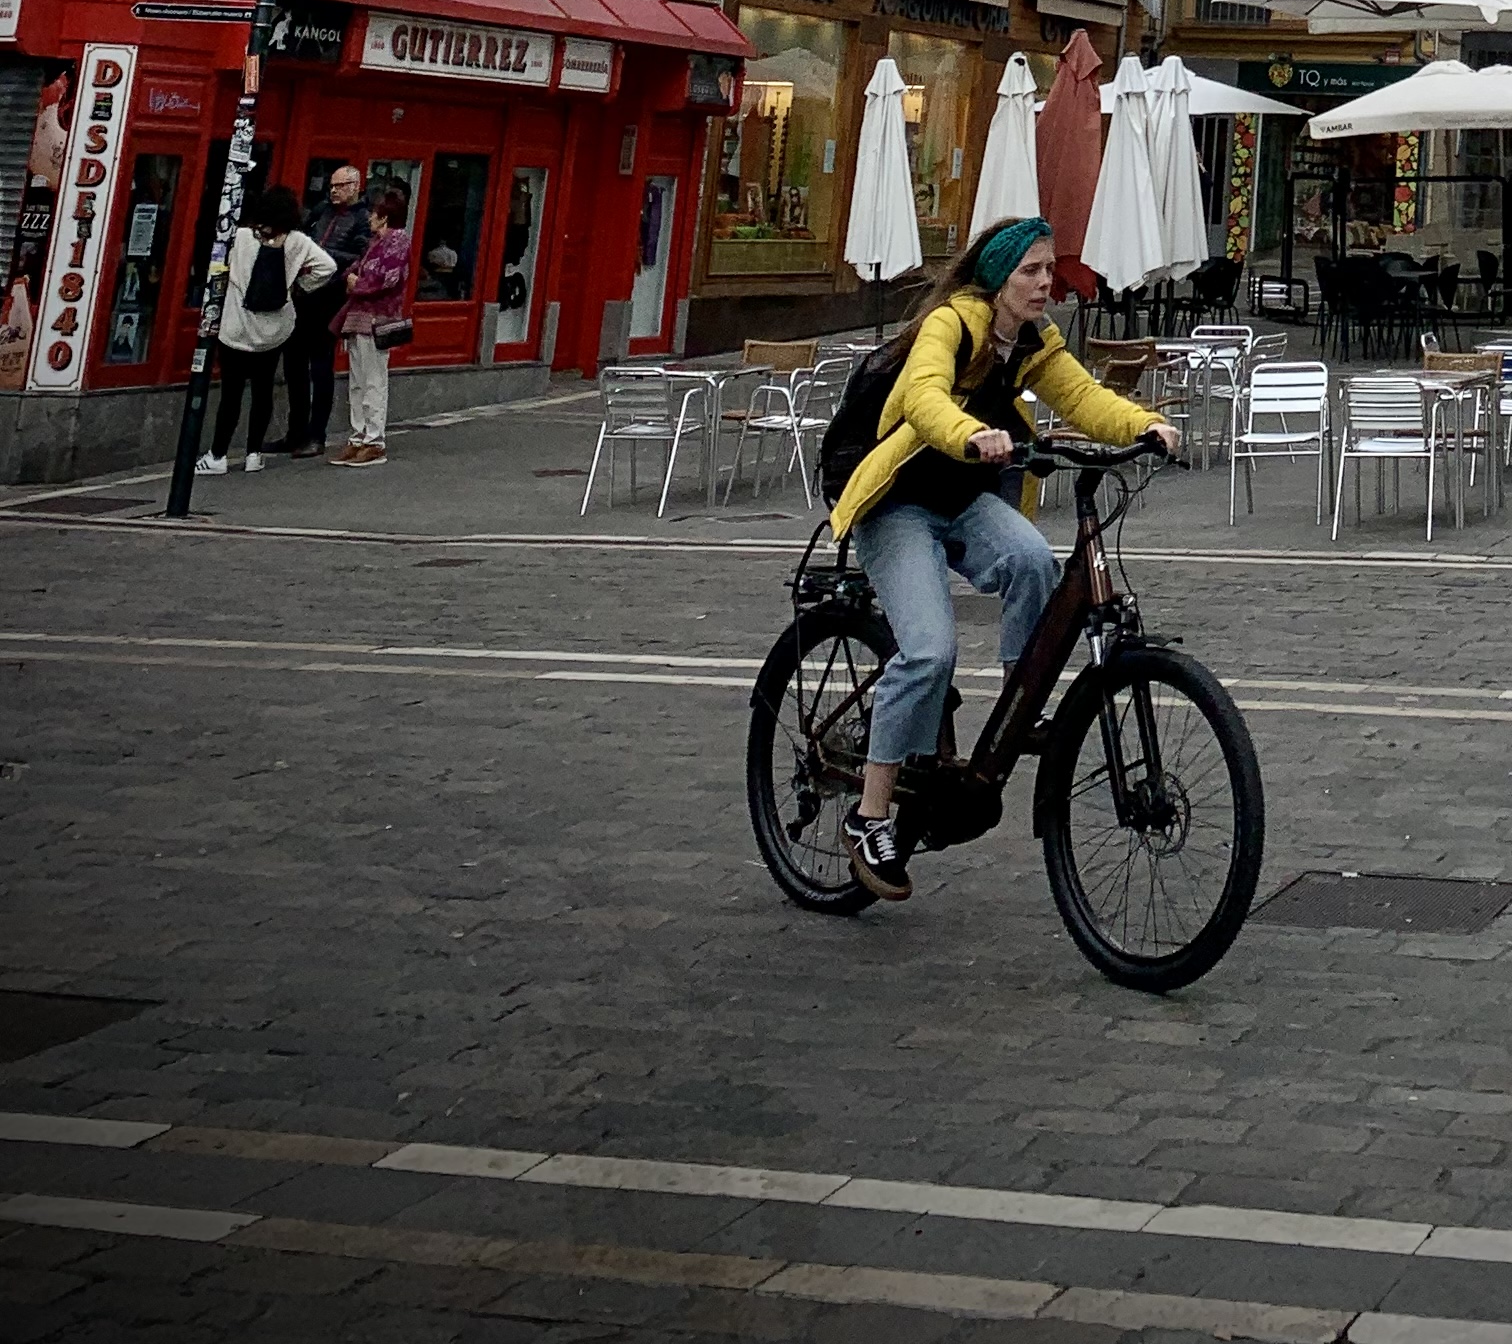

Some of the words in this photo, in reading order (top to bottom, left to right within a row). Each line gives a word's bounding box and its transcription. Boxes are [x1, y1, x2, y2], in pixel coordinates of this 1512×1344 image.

[294, 24, 342, 43] KANGOL
[391, 23, 530, 74] GUTIERREZ
[1299, 69, 1321, 88] TQ
[1323, 78, 1329, 86] y
[1330, 76, 1348, 86] más
[1325, 123, 1353, 134] AMBAR
[73, 58, 124, 221] DESDE
[20, 212, 51, 230] ZZZ
[47, 237, 88, 372] 1840
